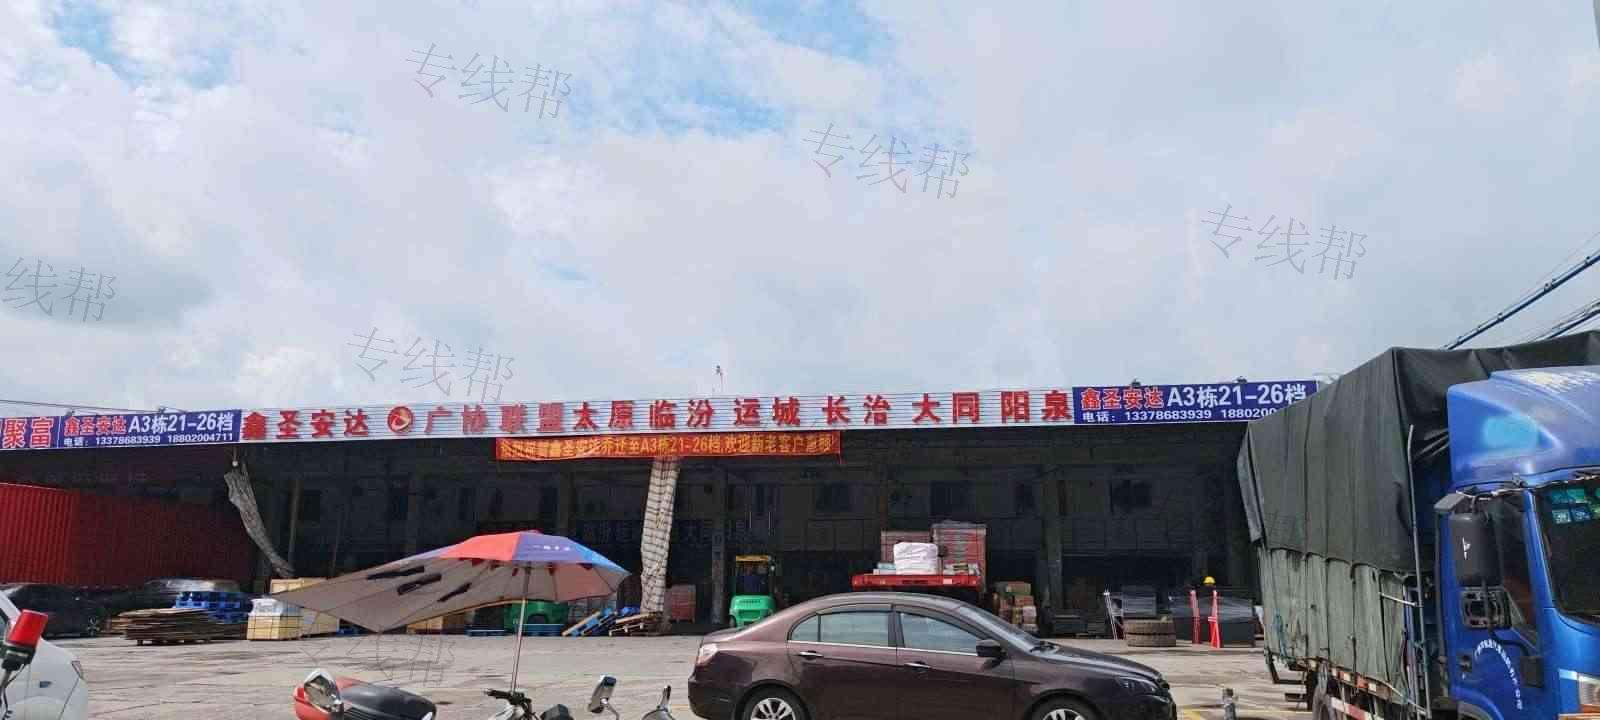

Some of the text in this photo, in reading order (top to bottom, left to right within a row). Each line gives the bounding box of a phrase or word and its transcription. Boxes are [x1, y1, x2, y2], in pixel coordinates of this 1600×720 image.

[1081, 383, 1307, 411] 鑫圣安达 A3栋21-26档
[128, 413, 233, 433] A3栋21-26档
[242, 408, 370, 440] 鑫圣安达
[1124, 410, 1212, 421] 13378683939
[2, 417, 54, 449] 聚富
[95, 435, 161, 445] 13378683939
[168, 433, 233, 443] 18802004711
